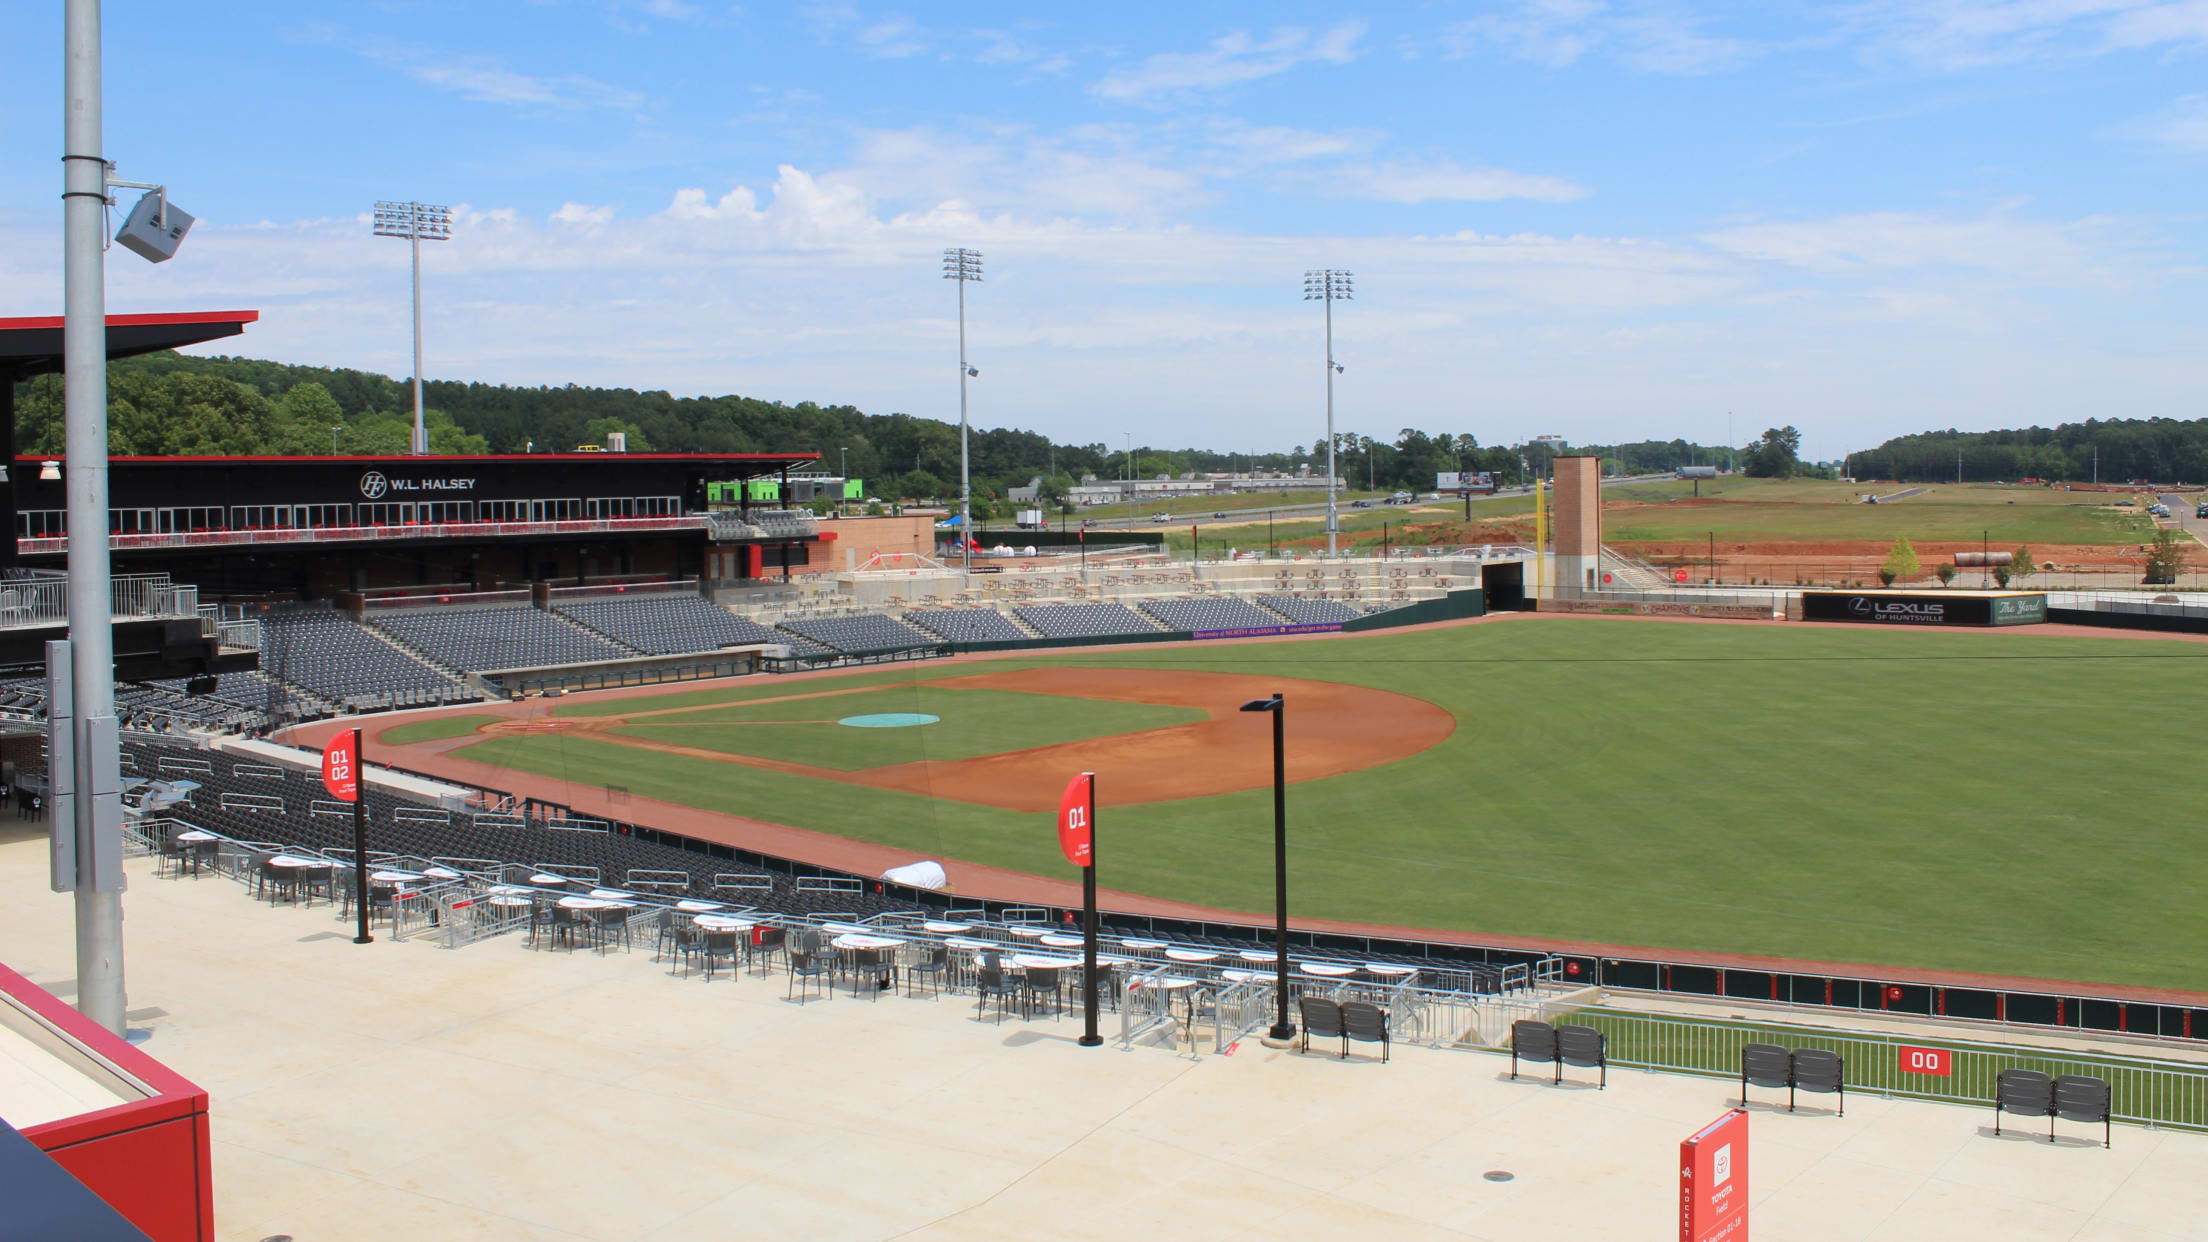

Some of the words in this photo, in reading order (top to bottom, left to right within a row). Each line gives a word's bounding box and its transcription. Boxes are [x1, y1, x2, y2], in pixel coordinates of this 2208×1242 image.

[390, 479, 420, 490] W.L.
[422, 478, 477, 490] HALSEY
[1874, 602, 1944, 615] LEXUS
[1889, 614, 1944, 622] HUNTSVILLE
[331, 749, 349, 765] 01
[331, 765, 349, 781] 02
[1069, 806, 1086, 830] 01
[1911, 1051, 1938, 1070] 00
[1711, 1184, 1733, 1205] TOYOTA
[1716, 1200, 1728, 1216] Field
